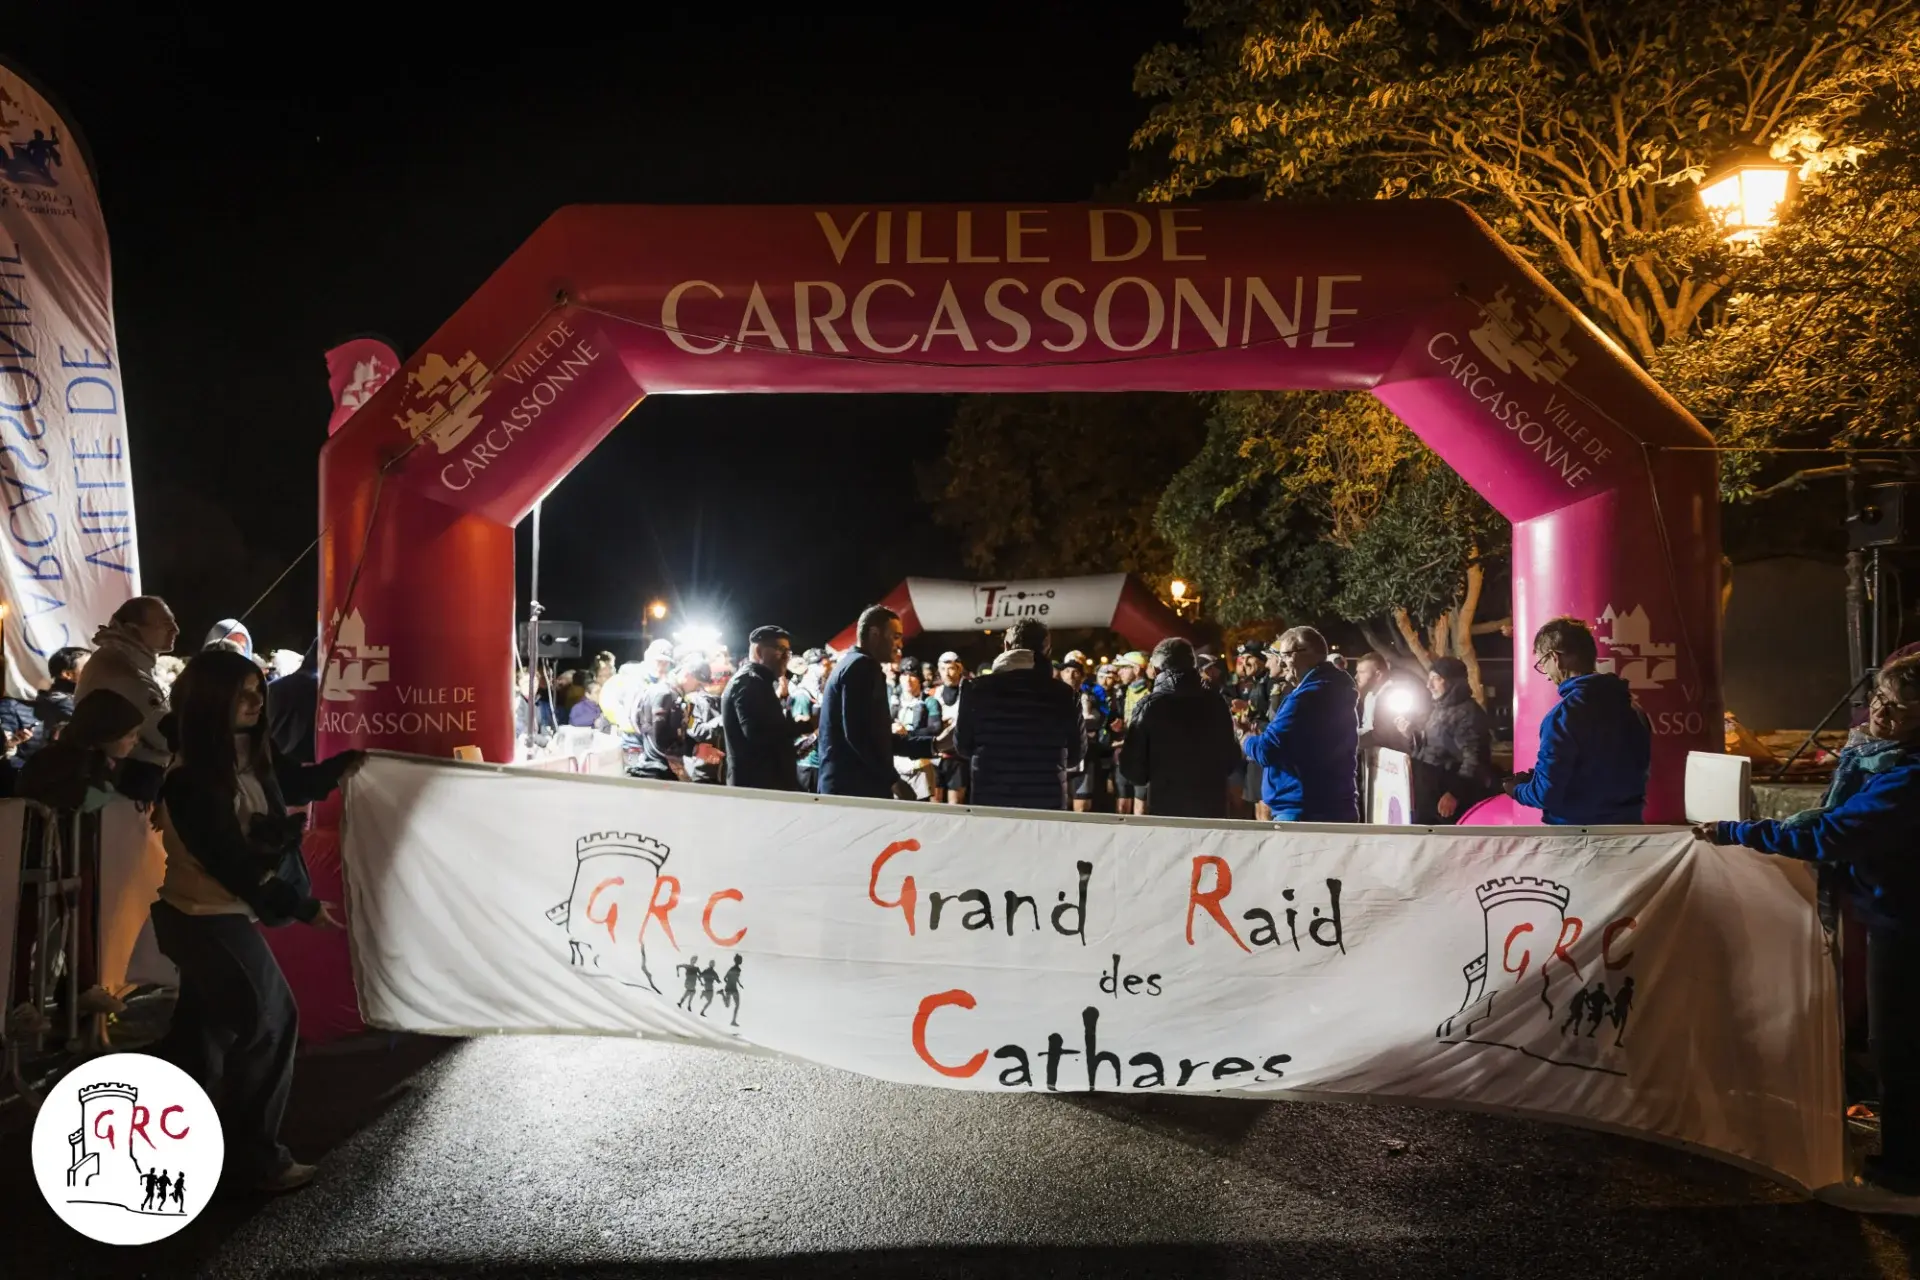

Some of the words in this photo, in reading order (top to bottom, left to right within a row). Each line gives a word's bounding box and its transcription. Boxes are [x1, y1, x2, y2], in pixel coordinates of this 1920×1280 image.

[815, 209, 1051, 265] VILLE
[1087, 207, 1207, 263] DE
[661, 274, 1363, 356] CARCASSONNE
[503, 342, 554, 386] VILLE
[547, 320, 576, 349] DE
[440, 339, 600, 492] CARCASSONNE
[1427, 332, 1592, 488] CARCASSONNE
[1544, 394, 1589, 444] VILLE
[1582, 441, 1612, 465] DE
[1004, 602, 1049, 617] Line
[396, 684, 447, 705] VILLE
[453, 686, 475, 703] DE
[586, 876, 748, 953] GRC
[868, 839, 1094, 946] Grand
[1185, 855, 1346, 955] Raid
[1100, 954, 1163, 999] des
[1503, 917, 1637, 984] GRC
[912, 989, 1292, 1092] Cathares
